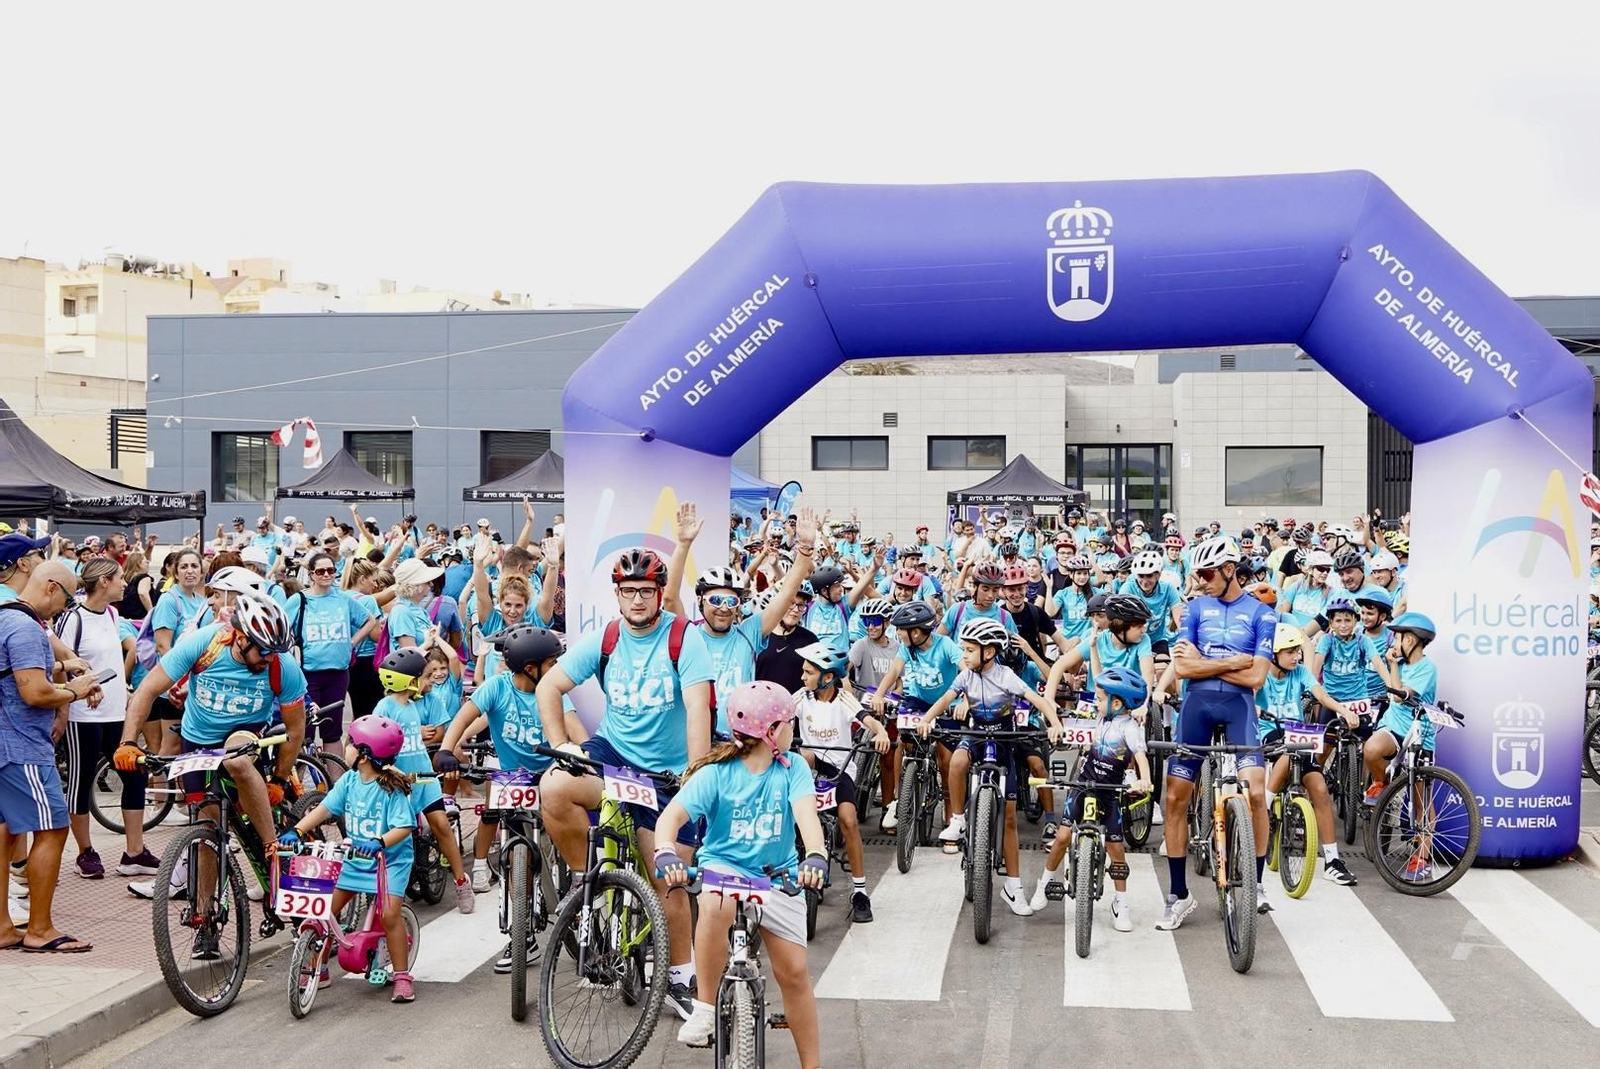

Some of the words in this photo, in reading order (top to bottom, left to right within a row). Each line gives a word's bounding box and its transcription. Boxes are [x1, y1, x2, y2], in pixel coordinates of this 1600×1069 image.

[1368, 244, 1414, 292] AYTO.
[1416, 287, 1445, 315] DE
[1441, 310, 1521, 388] HUÉRCAL
[639, 367, 688, 411] AYTO.
[684, 340, 713, 367] DE
[709, 273, 789, 345] HUÉRCAL
[1374, 288, 1404, 317] DE
[1397, 313, 1474, 385] ALMERÍA
[683, 380, 712, 406] DE
[710, 317, 784, 385] ALMERÍA
[149, 495, 158, 507] DE
[1453, 591, 1581, 628] Huércal
[1453, 633, 1580, 657] cercano
[196, 684, 264, 714] BICI
[222, 683, 240, 695] DE
[245, 688, 264, 699] LA
[608, 676, 674, 708] BICI
[1067, 729, 1093, 743] 361
[173, 758, 214, 776] 318
[496, 789, 537, 808] 399
[612, 782, 653, 805] 198
[1447, 793, 1489, 807] AYO.
[1494, 797, 1514, 808] DE
[1518, 794, 1573, 808] HUÉRCAL
[732, 806, 753, 818] DÍA
[766, 802, 782, 813] LA
[1496, 814, 1558, 829] ALMERÍA
[729, 813, 782, 840] BICI
[281, 893, 326, 916] 320
